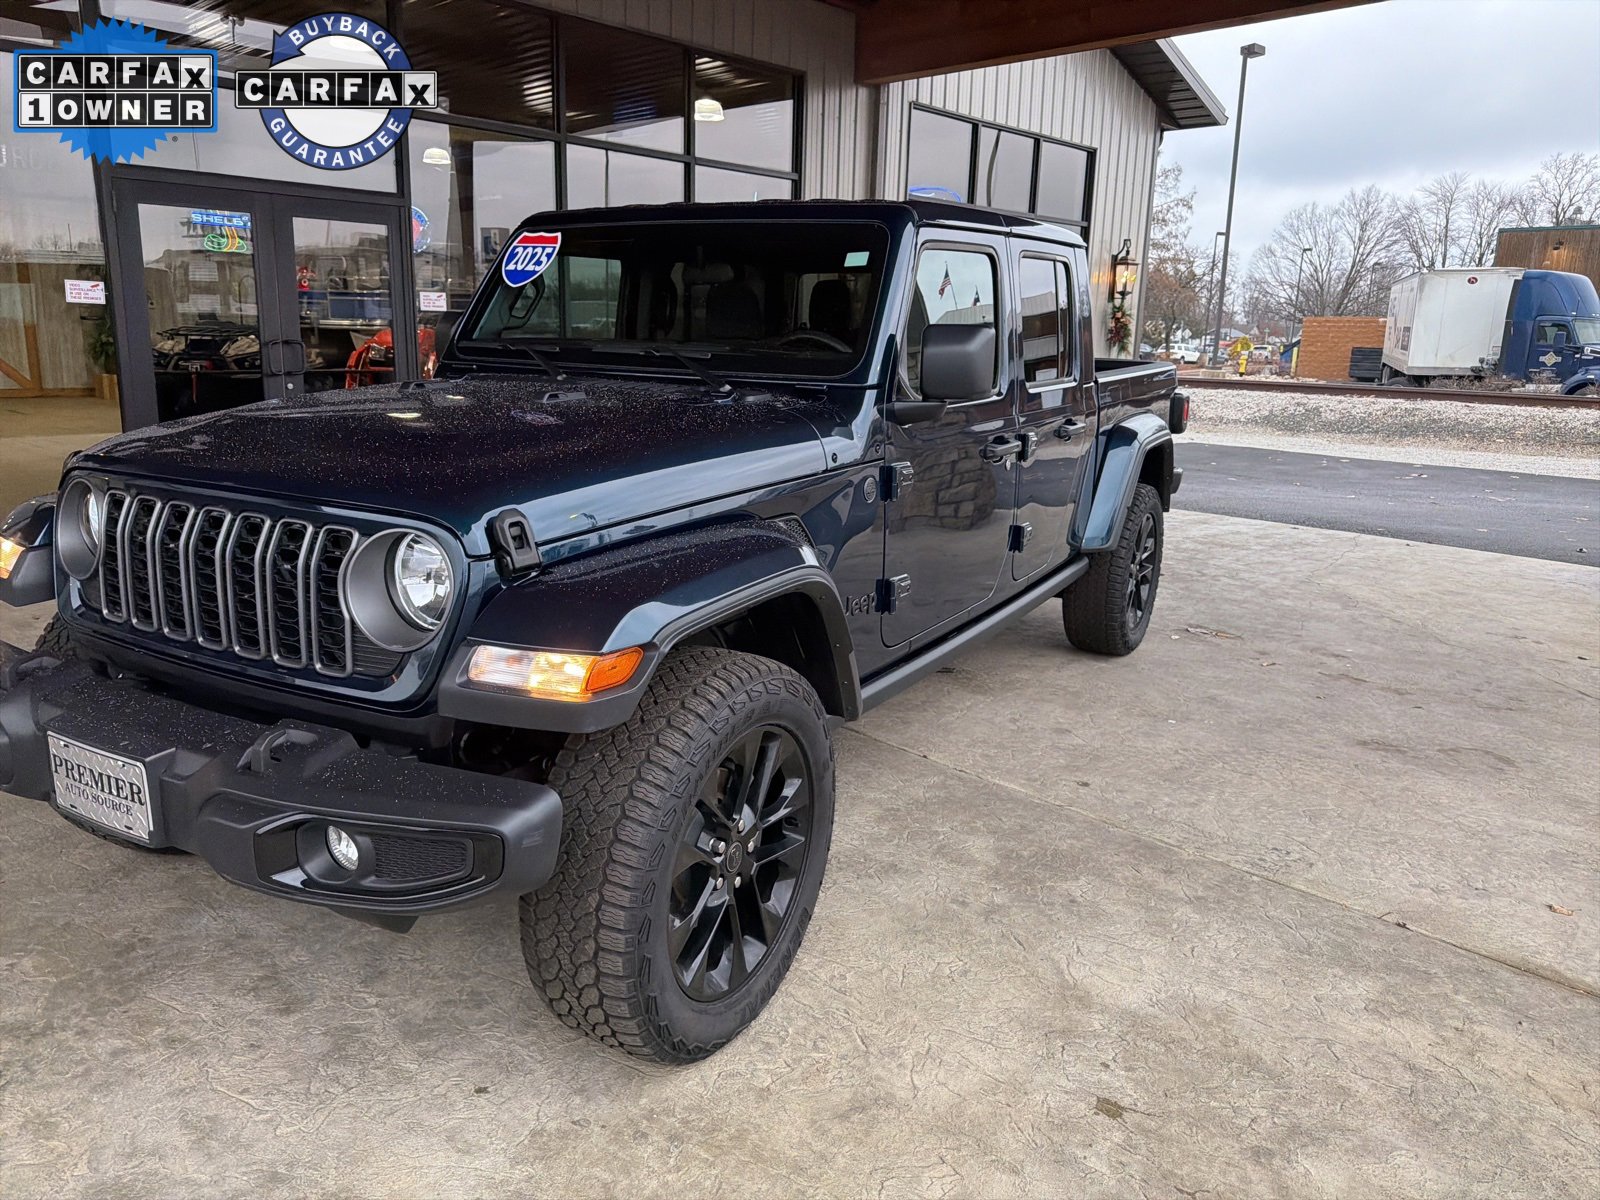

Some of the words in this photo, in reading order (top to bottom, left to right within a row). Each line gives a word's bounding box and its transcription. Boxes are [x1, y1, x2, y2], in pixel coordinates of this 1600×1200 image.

[505, 246, 554, 272] 2025
[51, 753, 146, 806] PREMIER
[65, 781, 89, 800] AUTO
[90, 792, 134, 816] SOURCE
